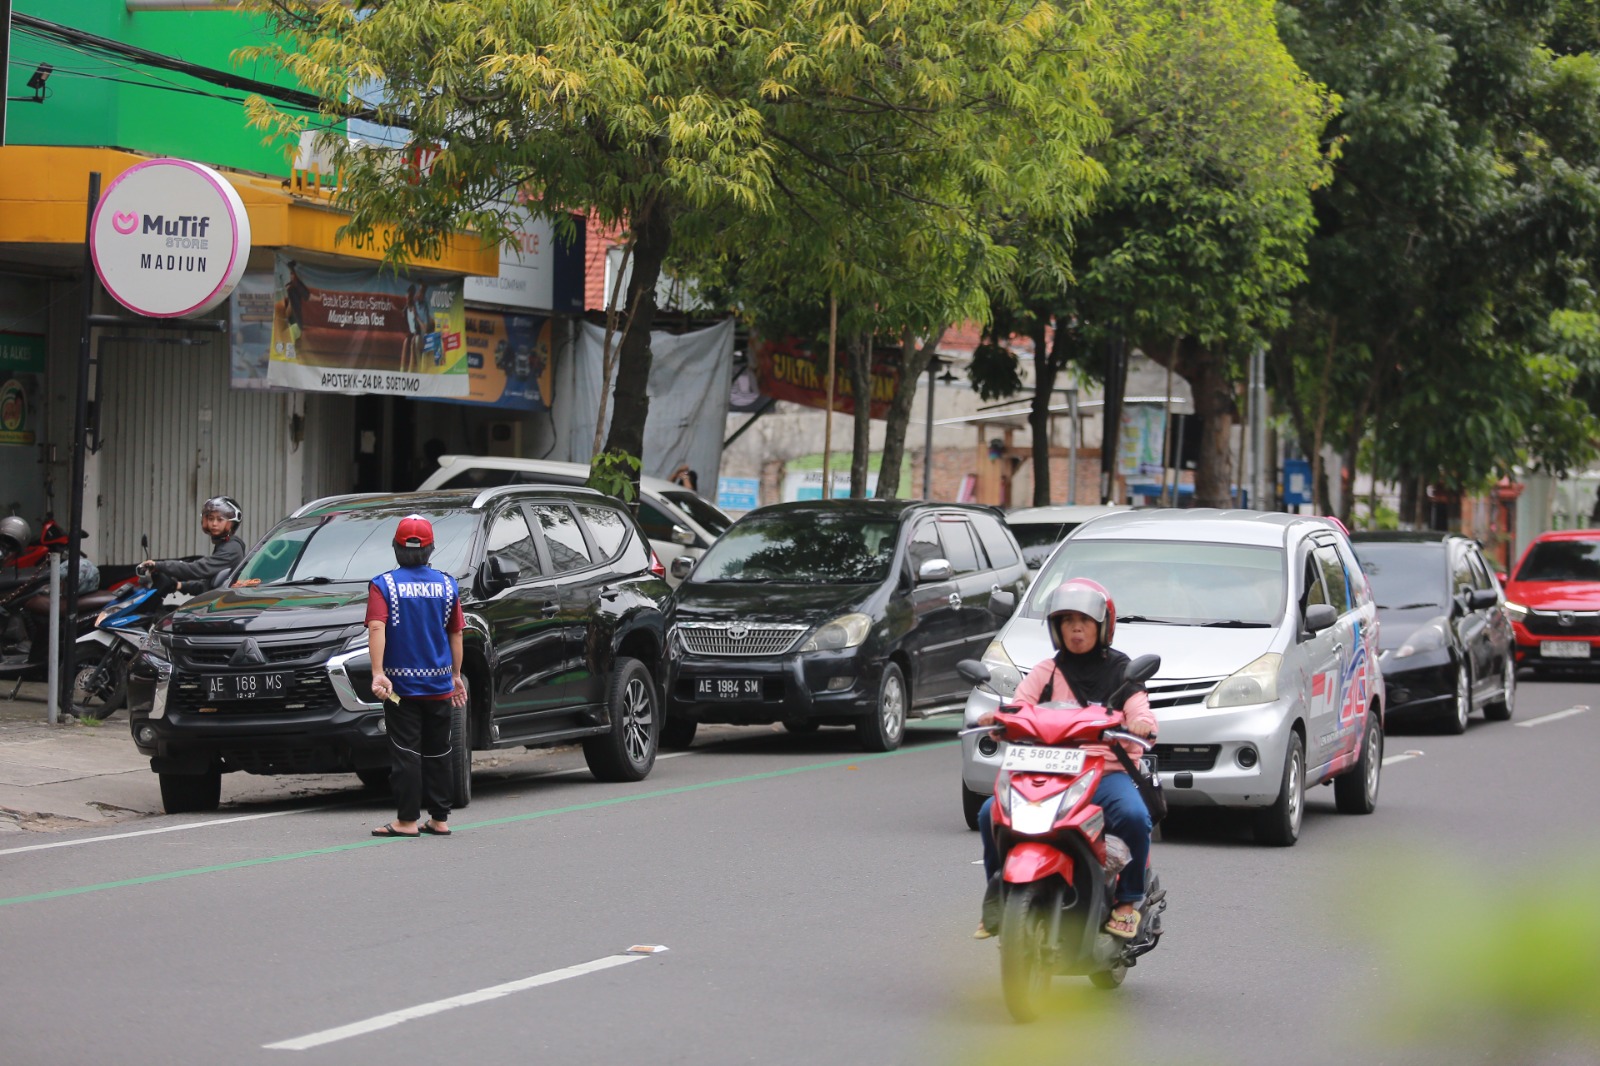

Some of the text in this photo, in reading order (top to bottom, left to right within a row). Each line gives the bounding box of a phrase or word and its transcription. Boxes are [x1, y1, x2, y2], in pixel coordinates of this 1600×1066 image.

[143, 214, 210, 237] MuTif
[165, 237, 209, 250] STORE
[140, 253, 207, 273] MADIUN
[321, 373, 351, 388] APOTEK
[373, 376, 385, 390] DR.
[386, 377, 420, 392] SOETOMO
[397, 582, 444, 598] PARKIR
[210, 674, 283, 692] AE 168 MS
[699, 680, 758, 692] AE 1984 SM
[1009, 748, 1081, 761] AE 5802 GK
